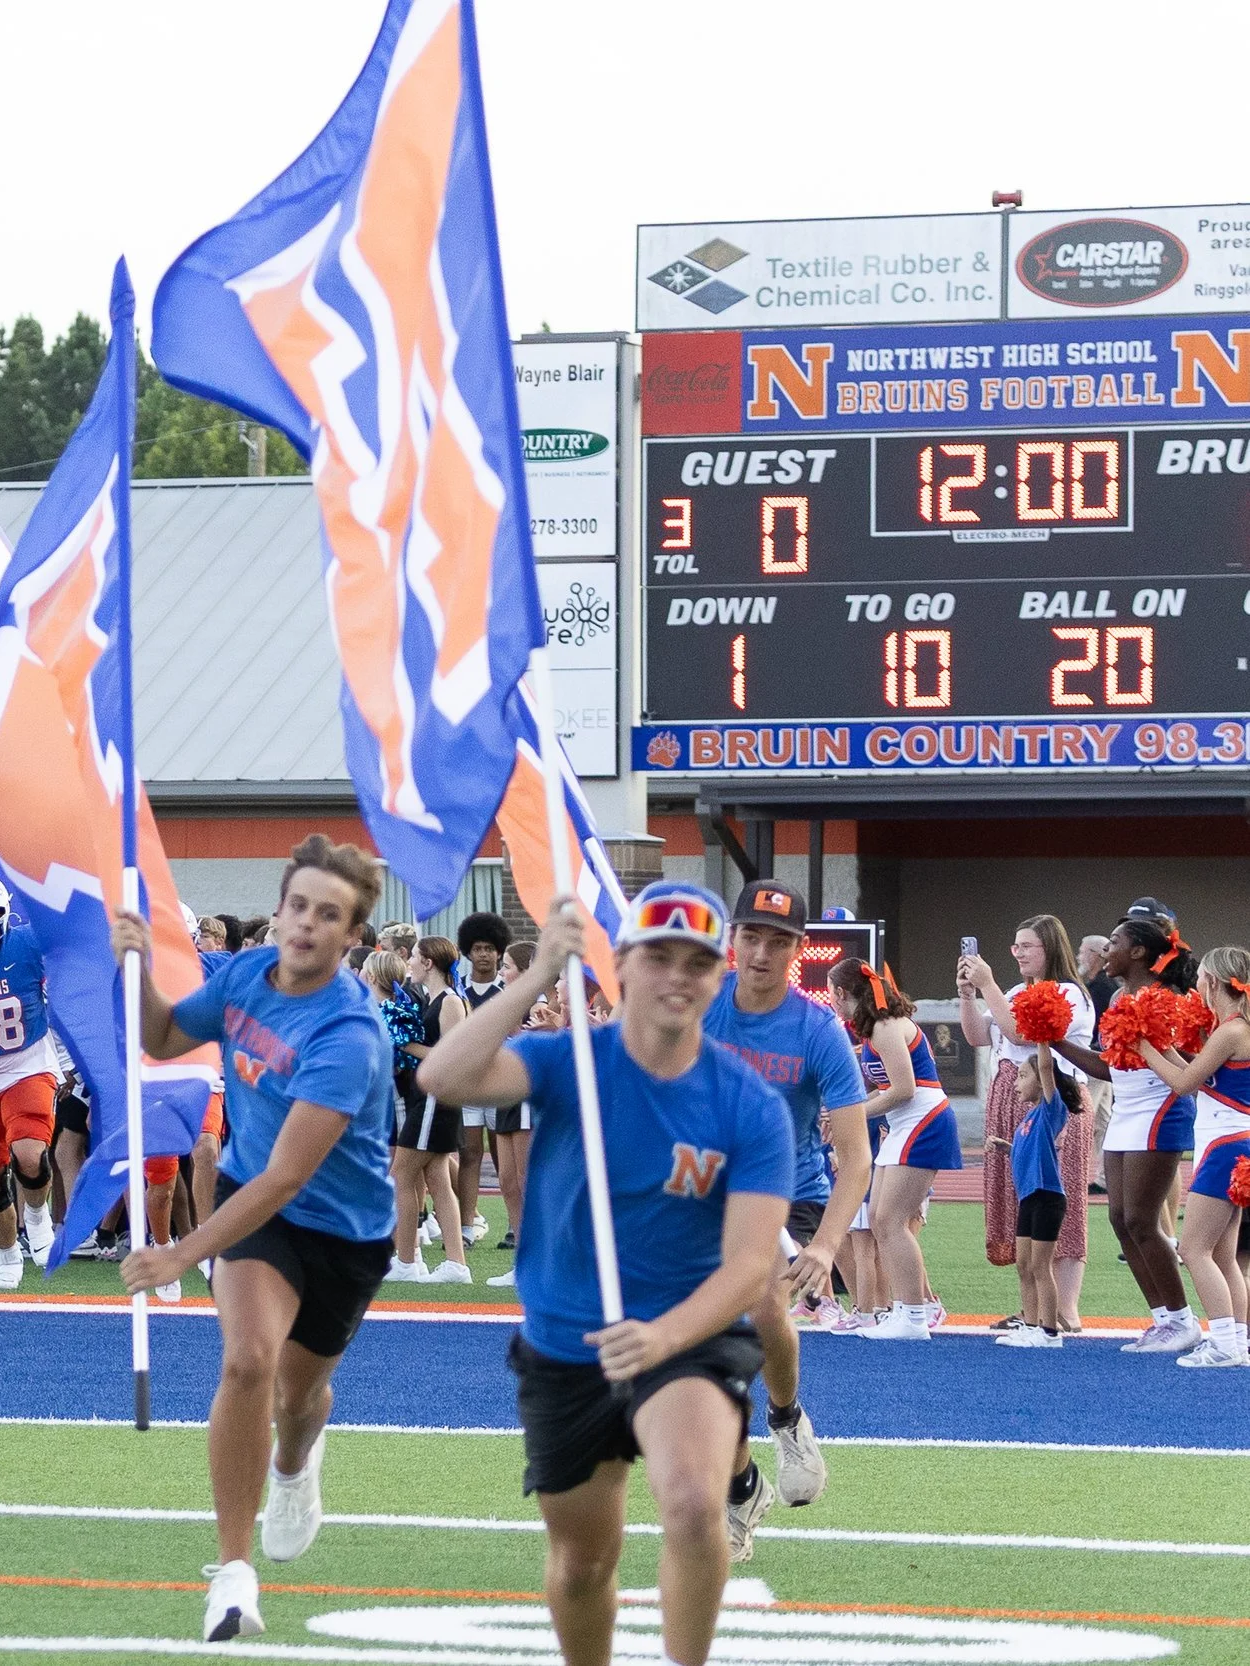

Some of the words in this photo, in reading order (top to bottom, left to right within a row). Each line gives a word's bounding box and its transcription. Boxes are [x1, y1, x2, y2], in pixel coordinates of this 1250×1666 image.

[766, 256, 854, 280] Textile
[863, 254, 963, 277] Rubber
[972, 252, 991, 273] &
[1056, 241, 1165, 268] CARSTAR
[755, 284, 880, 308] Chemical
[891, 282, 935, 304] Co.
[946, 280, 993, 302] Inc.
[568, 364, 605, 382] Blair
[847, 345, 995, 372] NORTHWEST
[1002, 343, 1060, 367] HIGH
[1067, 340, 1158, 365] SCHOOL
[1171, 328, 1250, 407] N
[748, 343, 835, 420] N
[837, 378, 969, 415] BRUINS
[980, 372, 1164, 411] FOOTBALL
[681, 448, 837, 486] GUEST
[918, 440, 1120, 523] 12:00
[530, 518, 598, 535] 278-3300
[662, 498, 692, 548] 3
[762, 496, 809, 574] 0
[653, 553, 700, 575] TOL
[666, 596, 777, 626] DOWN
[845, 593, 892, 623] TO
[904, 592, 956, 622] GO
[1019, 590, 1117, 619] BALL
[1132, 588, 1187, 616] ON
[731, 633, 746, 710] 1
[884, 629, 952, 708] 10
[1051, 625, 1153, 707] 20
[689, 726, 849, 767] BRUIN
[865, 723, 1121, 767] COUNTRY
[1134, 721, 1250, 763] 98.3
[663, 1142, 727, 1199] N
